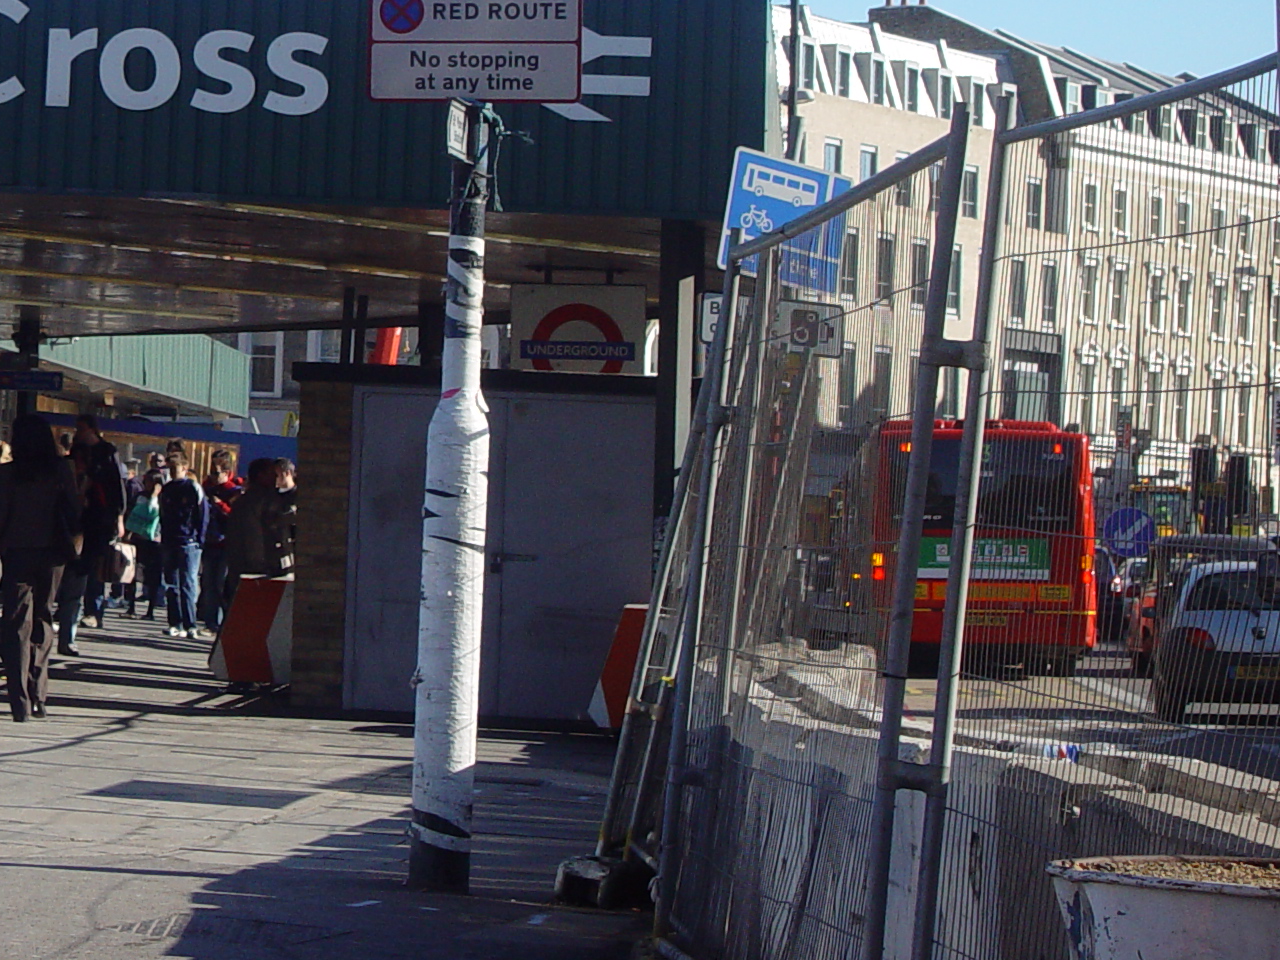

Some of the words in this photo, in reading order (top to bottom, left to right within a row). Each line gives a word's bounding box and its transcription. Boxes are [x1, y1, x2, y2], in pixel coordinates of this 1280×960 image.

[432, 2, 480, 20] RED
[488, 2, 568, 20] ROUTE
[410, 50, 441, 68] No
[447, 51, 540, 71] stopping
[414, 73, 437, 91] at
[442, 77, 480, 94] any
[487, 72, 534, 91] time
[526, 344, 629, 357] UNDERGROUND
